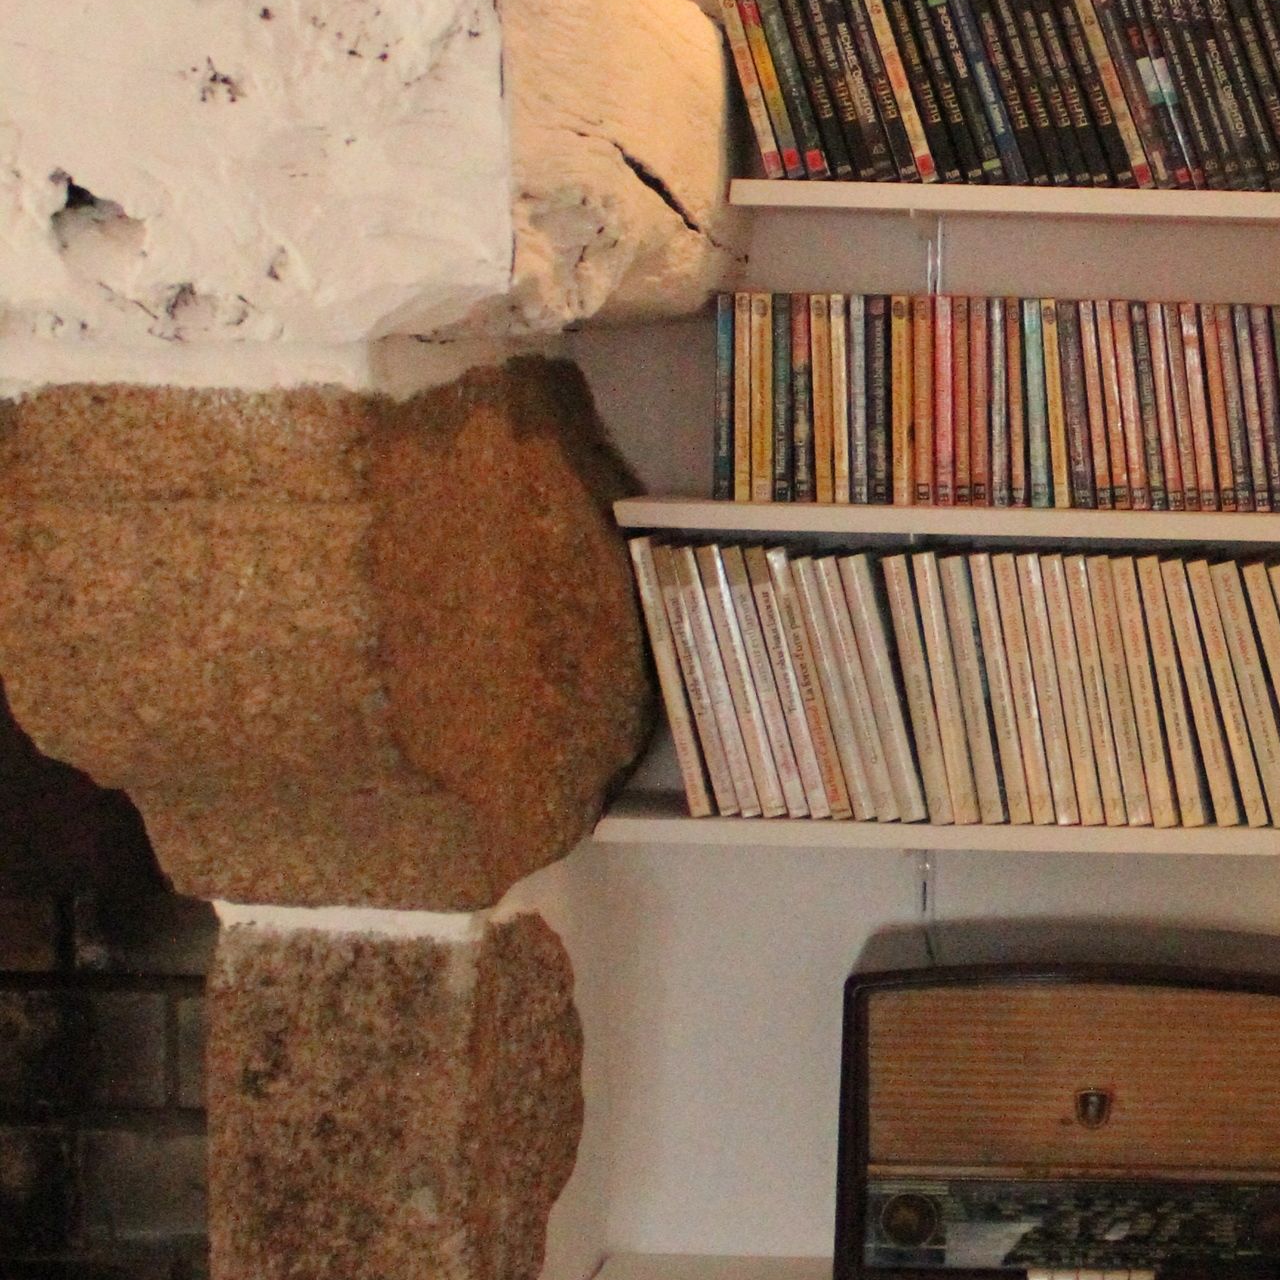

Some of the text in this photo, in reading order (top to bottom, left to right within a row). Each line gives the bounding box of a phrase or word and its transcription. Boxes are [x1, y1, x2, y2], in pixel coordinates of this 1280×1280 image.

[837, 22, 859, 69] MICHAEL
[936, 5, 959, 49] SURAGNE
[1206, 38, 1229, 83] MICHAEL
[795, 662, 812, 686] force
